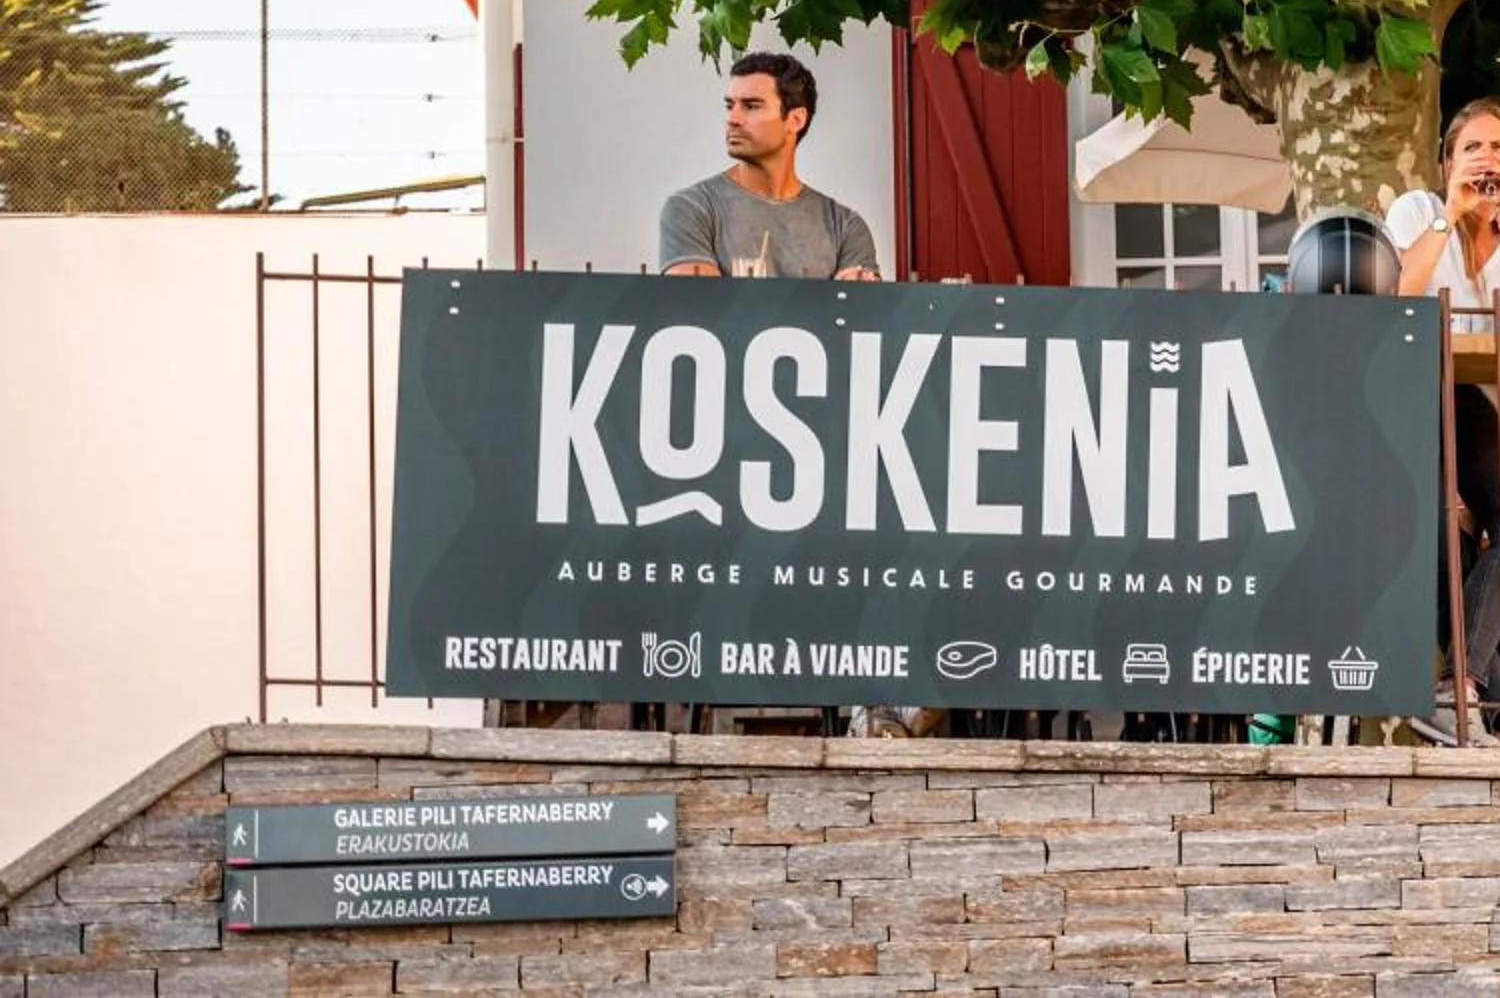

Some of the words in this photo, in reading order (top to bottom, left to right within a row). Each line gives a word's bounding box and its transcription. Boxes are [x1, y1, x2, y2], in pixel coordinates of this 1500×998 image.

[557, 560, 742, 586] AUBERGE
[773, 564, 976, 590] MUSICALE
[1005, 569, 1258, 596] GOURMANDE
[444, 636, 623, 673] RESTAURANT
[720, 641, 776, 676] BAR
[782, 637, 803, 676] À
[809, 642, 910, 678] VIANDE
[1019, 642, 1103, 682] HÔTEL
[1191, 645, 1312, 686] ÉPICERIE
[333, 806, 417, 829] GALERIE
[419, 805, 457, 827] PILI
[459, 801, 615, 825] TAFERNABERRY
[335, 832, 470, 855] ERAKUSTOKIA
[333, 871, 414, 896] SQUARE
[417, 869, 455, 891] PILI
[457, 864, 614, 889] TAFERNABERRY
[335, 897, 491, 920] PLAZABARATZEA
